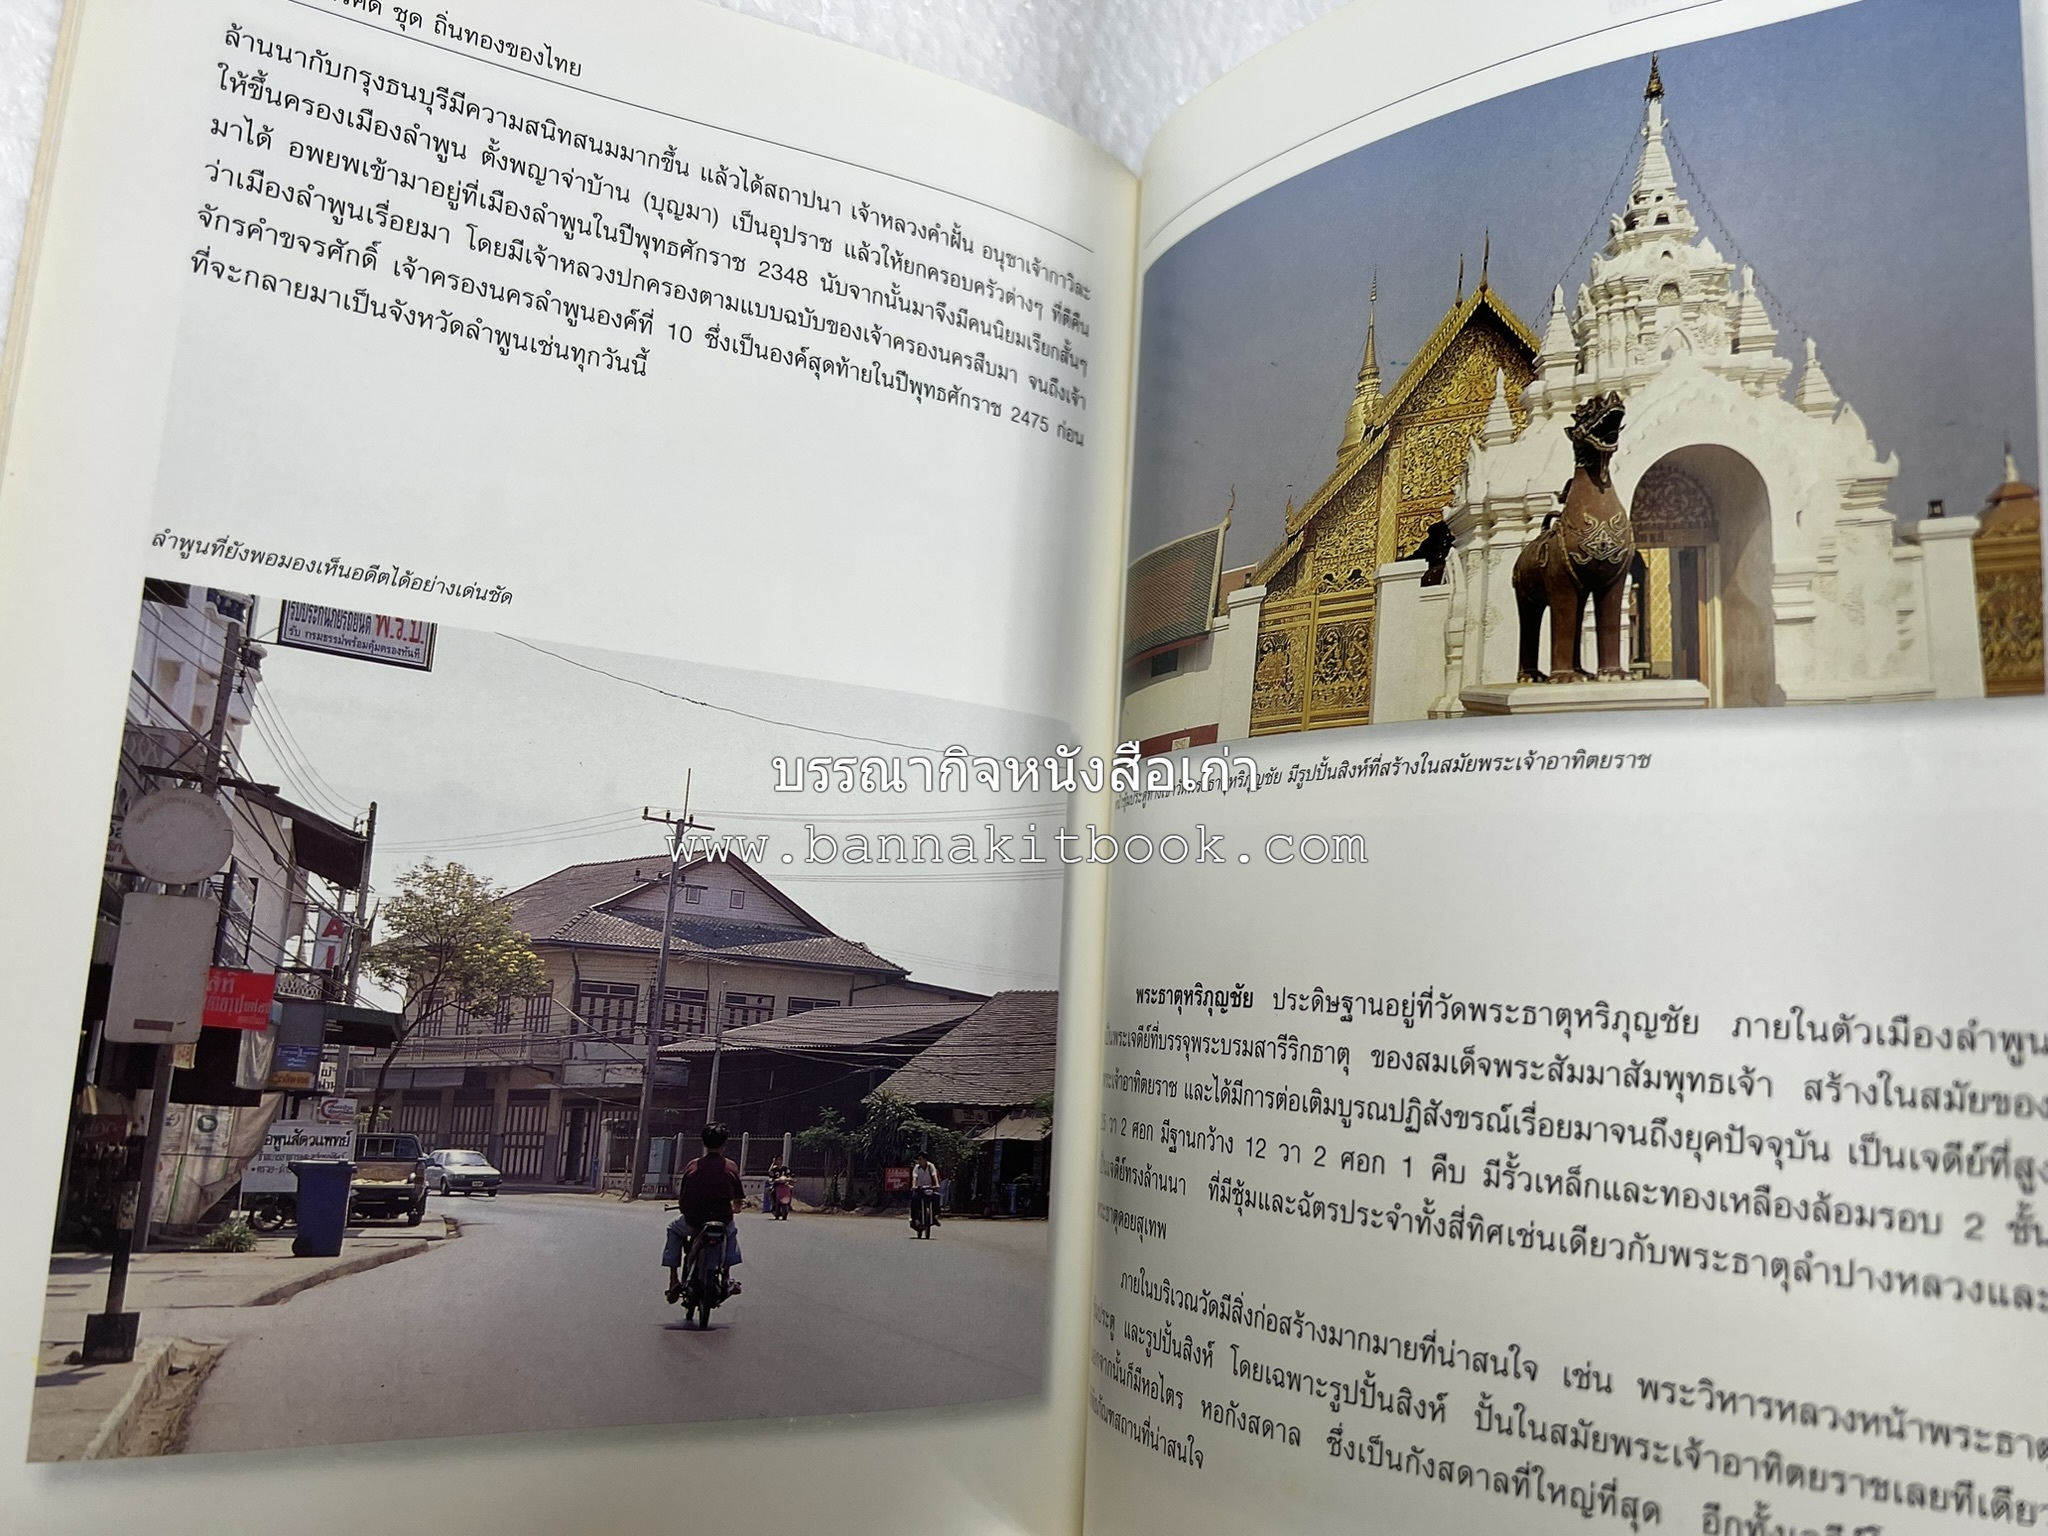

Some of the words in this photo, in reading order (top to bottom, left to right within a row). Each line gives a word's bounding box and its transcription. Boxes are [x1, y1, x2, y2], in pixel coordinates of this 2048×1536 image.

[393, 6, 423, 32] ชุด
[434, 10, 583, 78] ถิ่นทองของไทย
[210, 115, 273, 151] มาได้
[288, 138, 746, 272] อพยพเข้ามาอยู่ที่เมืองลำพูนในปีพุทธศักราช
[758, 260, 809, 287] 2348
[217, 62, 467, 163] ให้ขึ้นครองเมืองลำพูน
[481, 138, 630, 204] ตั้งพญาจ่าบ้าน
[643, 190, 719, 229] (บุญมา)
[732, 211, 832, 253] เป็นอุปราช
[844, 242, 1043, 321] แล้วให้ยกครอบครัวต่างๆ
[223, 23, 690, 177] ล้านนากับกรุงธนบุรีมีความสนิทสนมมากขึ้น
[701, 166, 842, 215] แล้วได้สถาปนา
[851, 201, 974, 254] เจ้าหลวงคำฝั้น
[190, 245, 648, 378] ที่จะกลายมาเป็นจังหวัดลำพูนเช่นทุกวันนี้
[197, 202, 382, 271] จักรคำขจรศักดิ์
[394, 256, 654, 337] เจ้าครองนครลำพูนองค์ที่
[667, 322, 693, 344] 10
[704, 323, 1001, 418] ซึ่งเป็นองค์สุดท้ายในปีพุทธศักราช
[1011, 406, 1049, 433] 2475
[1057, 420, 1085, 447] ก่อน
[205, 159, 451, 245] ว่าเมืองลำพูนเรื่อยมา
[1029, 376, 1086, 410] จนถึงเจ้า
[151, 528, 513, 606] ลำพูนที่ยังพอมองเห็นอดีตได้อย่างเด่นชัด
[1135, 982, 1254, 1016] พระธาตุหริภุญชัย
[1273, 985, 1699, 1042] ประดิษฐานอยู่ที่วัดพระธาตุหริภุญชัย
[1731, 1006, 2048, 1067] ภายในตัวเมืองลำพูน
[1371, 1045, 1774, 1102] ของสมเด็จพระสัมมาสัมพุทธเจ้า
[1120, 1117, 1127, 1136] 2
[1132, 1121, 1154, 1142] ศอก
[1160, 1119, 1233, 1155] มีฐานกว้าง
[1245, 1136, 1267, 1159] 12
[1279, 1143, 1301, 1164] วา
[1313, 1145, 1327, 1168] 2
[1340, 1150, 1386, 1176] ศอก
[1402, 1156, 1413, 1179] 1
[1431, 1152, 1466, 1185] คืบ
[1483, 1151, 1942, 1237] มีรั้วเหล็กและทองเหลืองล้อมรอบ
[1964, 1211, 1986, 1243] 2
[1120, 1267, 1539, 1383] ภายในบริเวณวัดมีสิ่งก่อสร้างมากมายที่น่าสนใจ
[1563, 1361, 1613, 1394] เช่น
[1124, 1319, 1215, 1368] และรูปปั้นสิงห์
[1231, 1344, 1448, 1424] โดยเฉพาะรูปปั้นสิงห์
[1201, 1396, 1301, 1448] หอกังสดาล
[1327, 1421, 1662, 1534] ซึ่งเป็นกังสดาลที่ใหญ่ที่สุด
